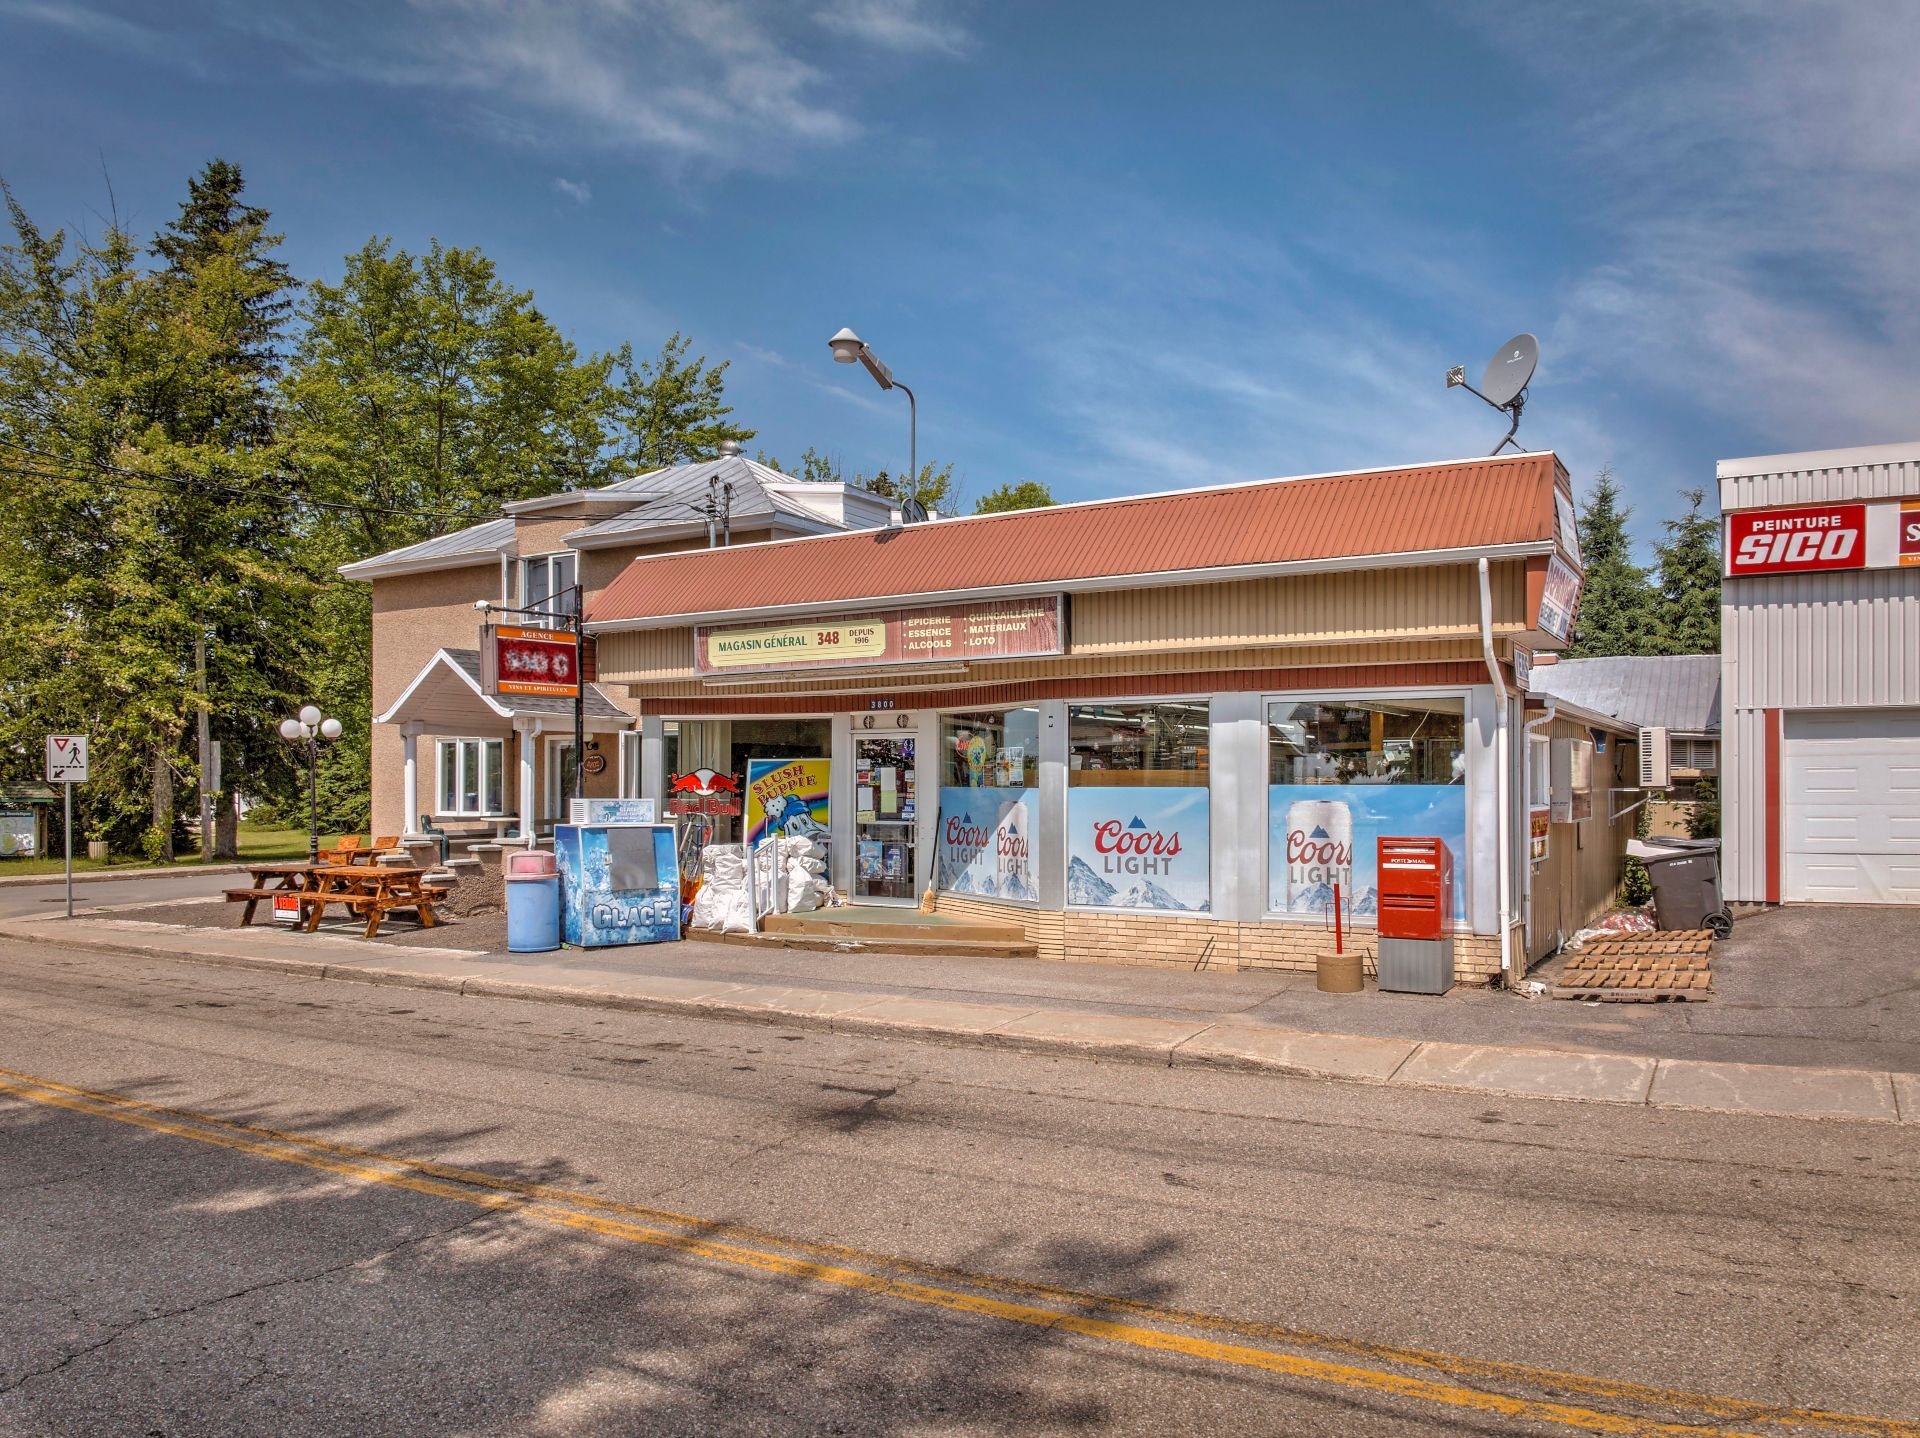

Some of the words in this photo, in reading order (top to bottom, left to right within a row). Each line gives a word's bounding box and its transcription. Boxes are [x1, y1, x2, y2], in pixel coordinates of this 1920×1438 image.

[1752, 515, 1842, 532] PEINTURE
[1735, 528, 1858, 565] SICO
[908, 615, 952, 626] ÉPICERIE
[969, 622, 1027, 634] MATÉRIAUX
[718, 637, 762, 652] MAGASIN
[765, 633, 807, 649] GÉNÉRAL
[817, 631, 840, 646] 348
[849, 627, 875, 637] DEPUIS
[854, 636, 869, 645] 1916
[908, 627, 952, 637] ESSENCE
[970, 636, 995, 646] LOTO
[908, 639, 952, 650] ALCOOLS
[870, 700, 894, 709] 3800
[752, 764, 805, 794] SLUSH
[756, 774, 817, 807] PUPPIE
[669, 797, 705, 815] Red
[706, 797, 741, 816] Bull
[946, 815, 989, 848] Coors
[1093, 819, 1182, 856] Coors
[950, 846, 985, 865] LIGHT
[1104, 856, 1172, 876] LIGHT
[1290, 866, 1351, 886] LIGHT
[593, 900, 673, 929] GLACE
